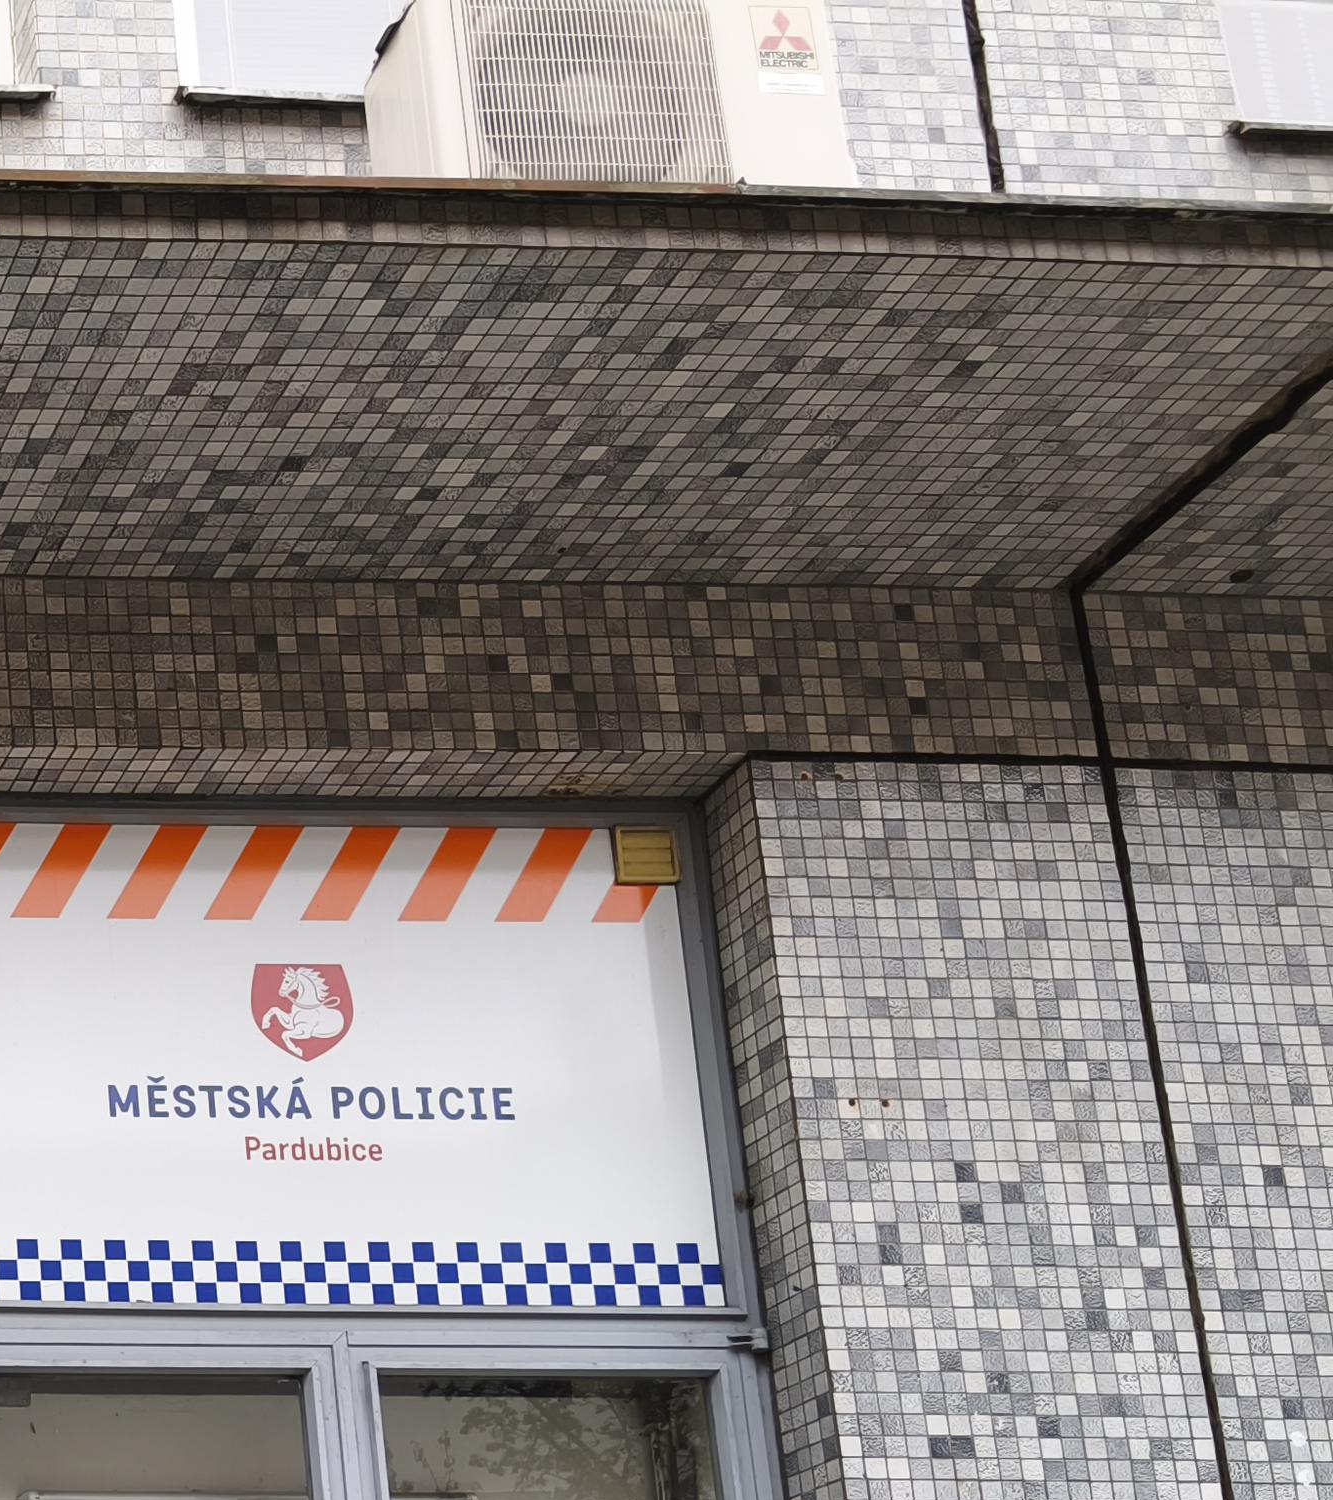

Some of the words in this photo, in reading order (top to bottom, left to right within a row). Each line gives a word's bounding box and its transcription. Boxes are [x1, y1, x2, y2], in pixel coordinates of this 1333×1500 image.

[759, 51, 814, 60] MITSUBISHI
[761, 59, 808, 68] ELECTRIC
[107, 1076, 312, 1119] MĚSTSKÁ
[331, 1086, 516, 1121] POLICIE
[245, 1136, 383, 1161] Pardubice
